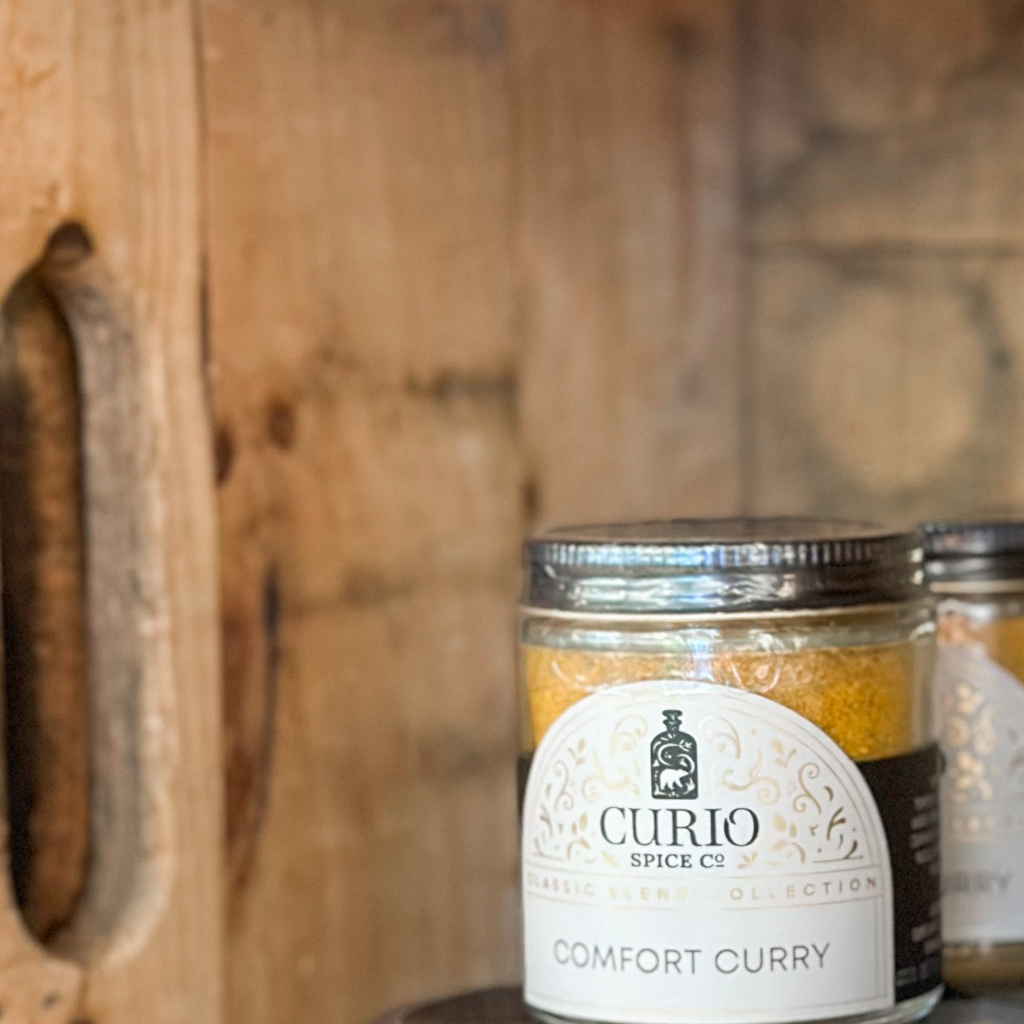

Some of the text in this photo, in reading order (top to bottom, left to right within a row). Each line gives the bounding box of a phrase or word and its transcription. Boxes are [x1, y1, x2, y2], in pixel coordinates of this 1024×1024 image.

[599, 806, 760, 848] CURIO
[630, 852, 693, 869] SPICE
[553, 938, 831, 975] COMFORT CURRY
